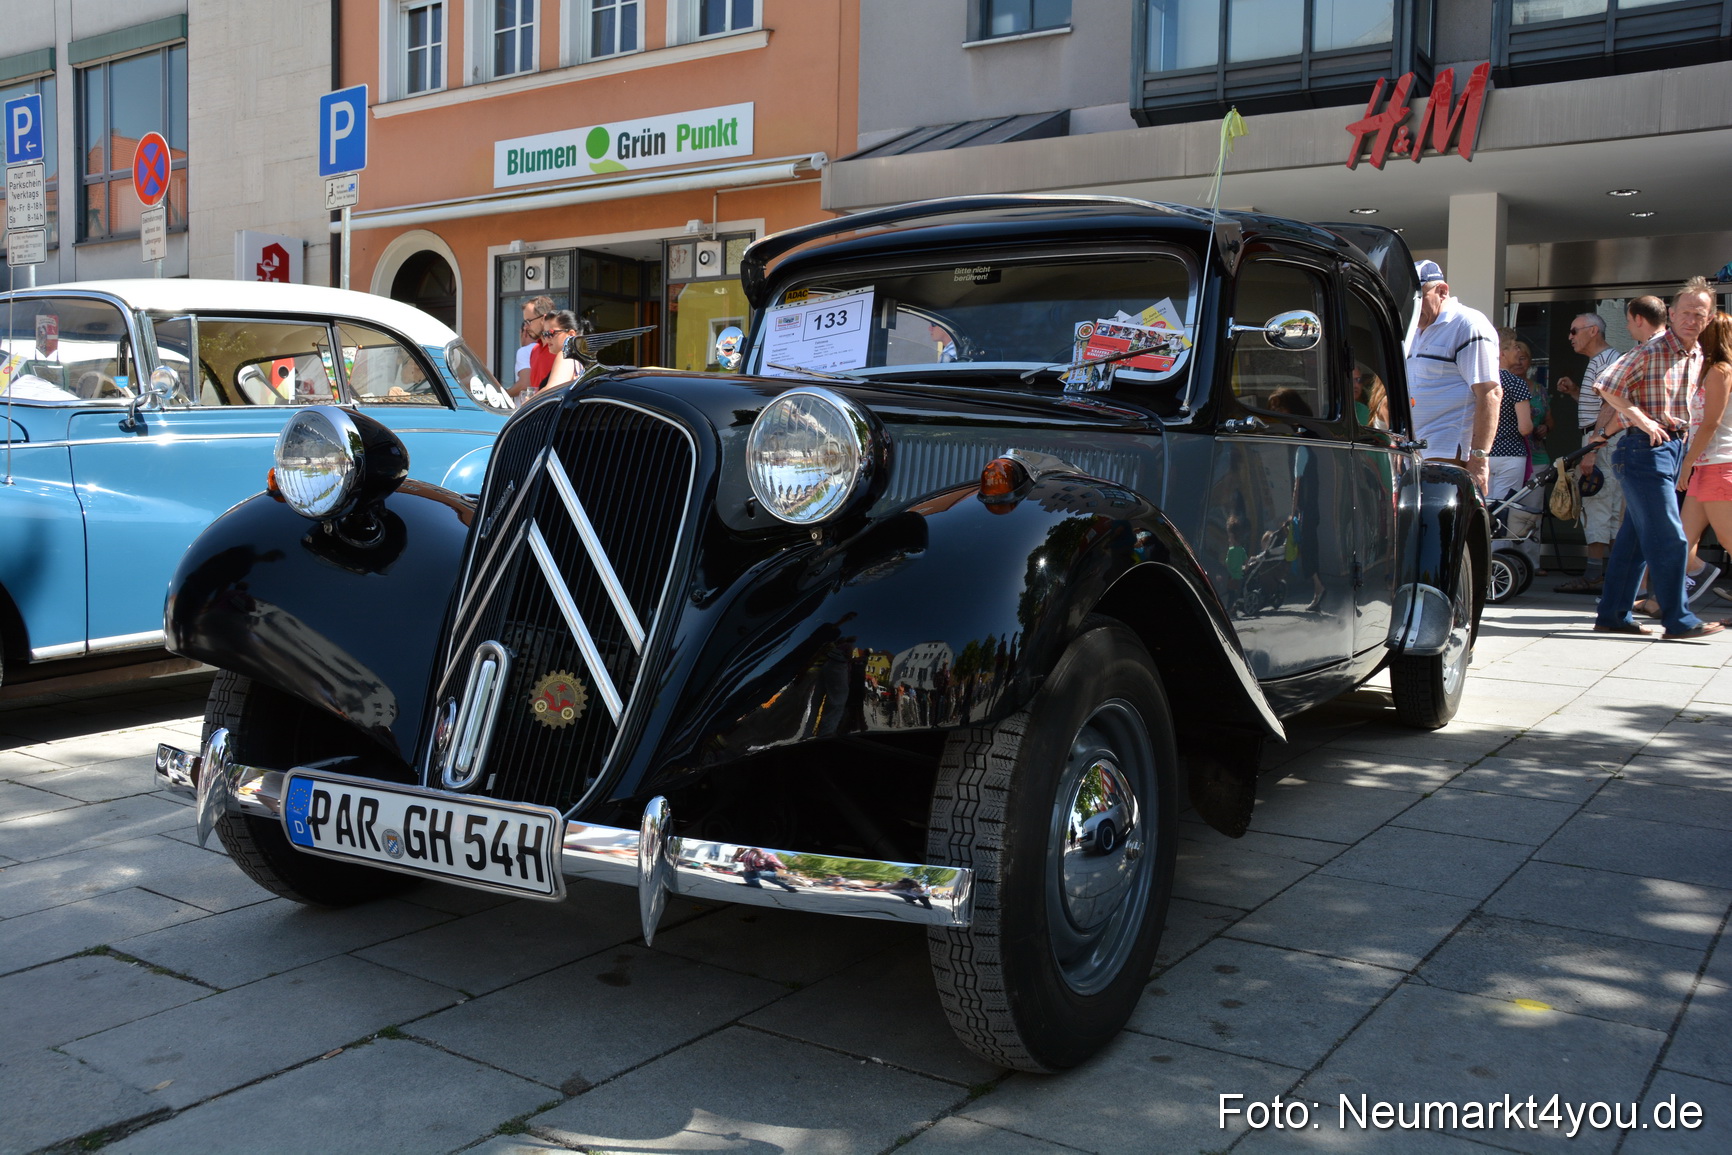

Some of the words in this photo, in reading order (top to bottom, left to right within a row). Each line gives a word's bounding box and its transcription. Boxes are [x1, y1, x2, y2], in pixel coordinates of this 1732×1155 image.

[1345, 62, 1491, 170] H&M
[13, 106, 32, 154] P
[330, 101, 355, 165] P
[506, 143, 577, 176] Blumen
[617, 128, 666, 160] Grün
[676, 117, 738, 153] Punkt
[14, 172, 24, 180] nur
[25, 169, 36, 178] mit
[9, 179, 41, 190] Parkschein
[12, 191, 39, 199] werktags
[9, 215, 16, 224] Sa
[786, 288, 809, 300] ADAC
[814, 309, 848, 331] 133
[294, 820, 305, 834] D
[311, 789, 381, 852] PAR
[403, 804, 454, 866] GH
[464, 814, 545, 883] 54H
